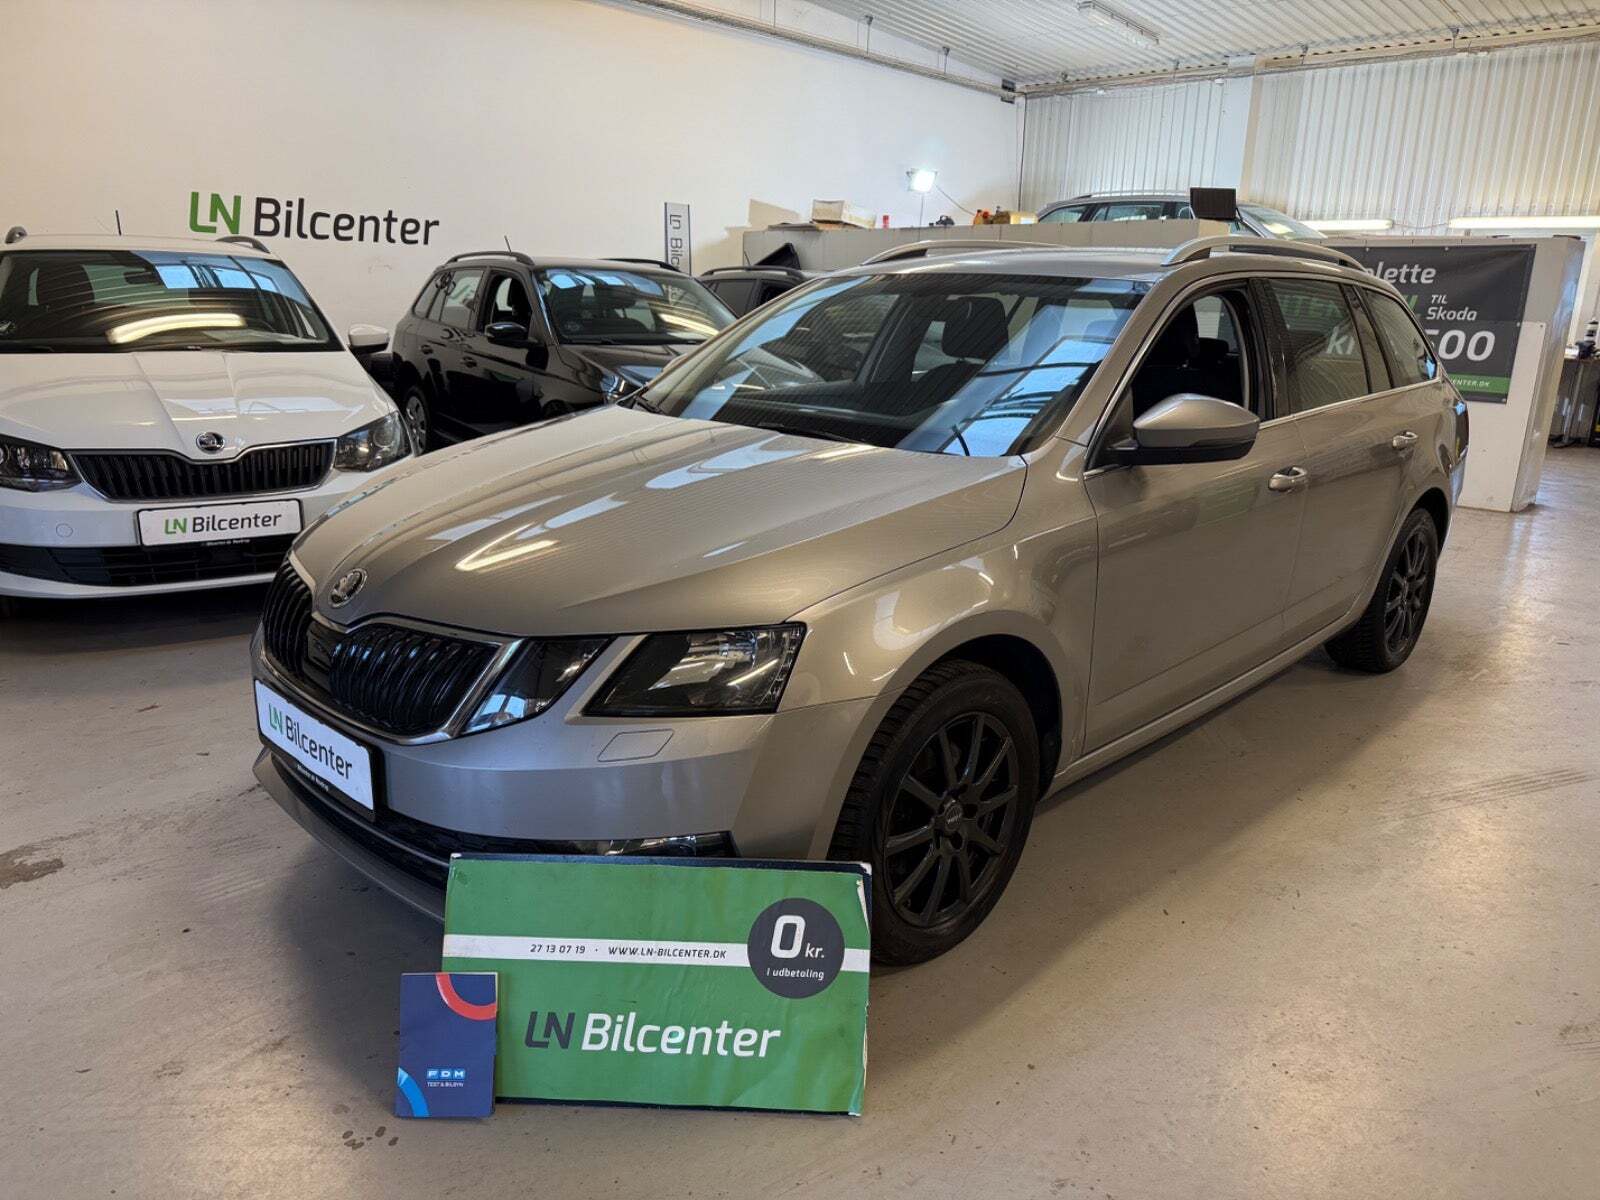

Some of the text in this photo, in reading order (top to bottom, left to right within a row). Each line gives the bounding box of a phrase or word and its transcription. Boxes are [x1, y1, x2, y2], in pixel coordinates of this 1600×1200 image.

[189, 191, 440, 245] LN Bilcenter
[670, 237, 683, 269] Bilc
[1431, 294, 1448, 305] TIL
[1426, 306, 1478, 321] Skoda
[164, 513, 282, 535] LN Bilcenter
[268, 703, 283, 735] LN
[285, 715, 352, 780] Bilcenter
[770, 914, 825, 959] 0 kr.
[530, 944, 727, 959] 27 13 07 19 WWW.LN-BILCENTER.DK
[772, 968, 824, 981] udbetaling
[525, 1011, 782, 1059] LN Bilcenter
